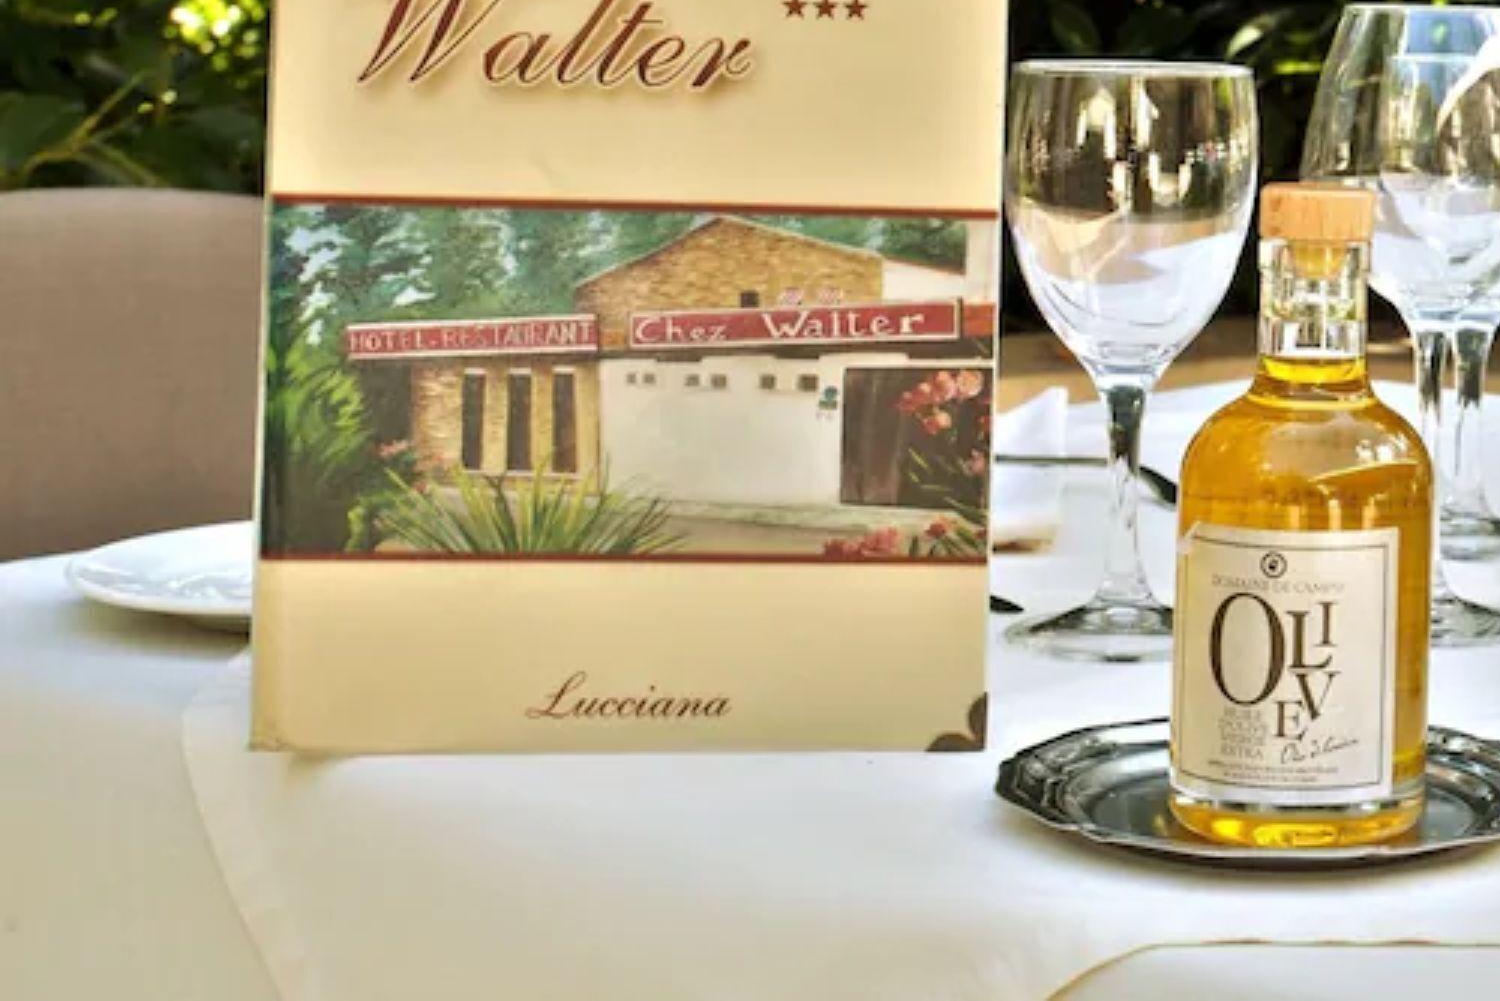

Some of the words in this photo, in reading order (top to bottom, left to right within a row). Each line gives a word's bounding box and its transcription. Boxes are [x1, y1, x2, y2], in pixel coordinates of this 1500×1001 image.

[634, 315, 728, 343] Chez
[760, 308, 925, 339] Walter
[525, 671, 731, 719] Lucciana
